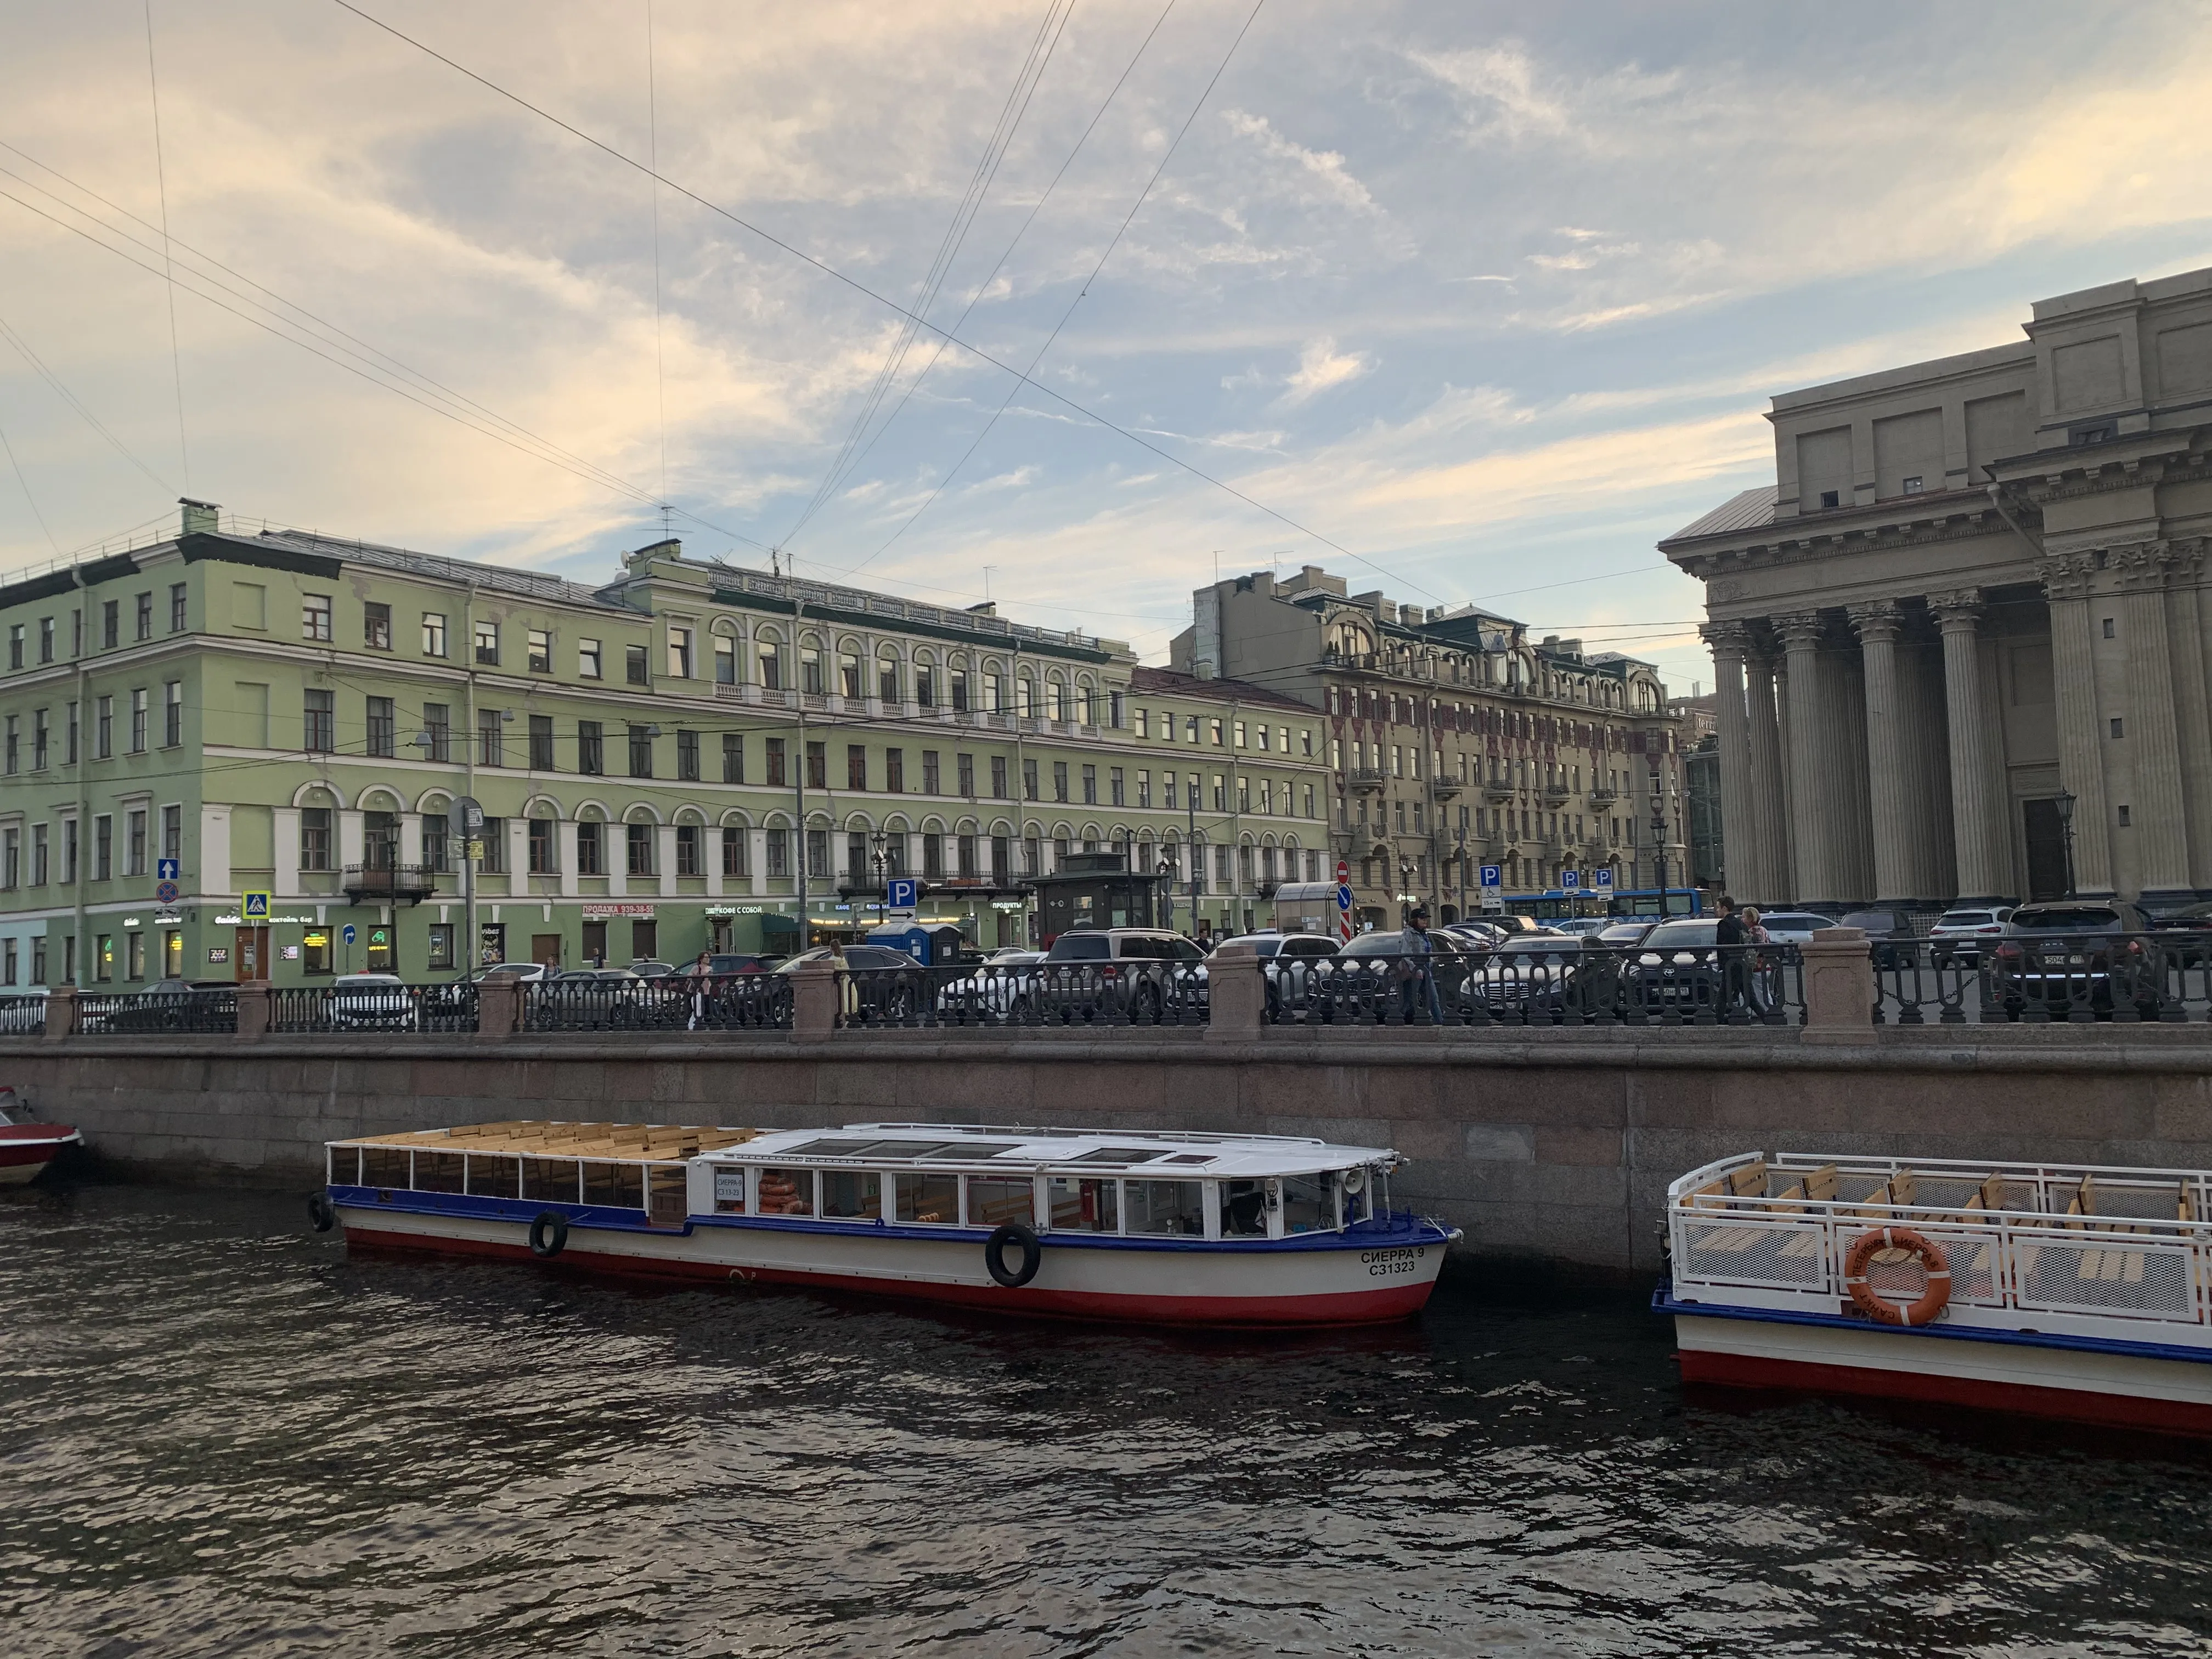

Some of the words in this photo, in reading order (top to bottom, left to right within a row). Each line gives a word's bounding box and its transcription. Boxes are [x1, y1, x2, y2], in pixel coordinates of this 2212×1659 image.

[1485, 868, 1496, 885] P
[1566, 872, 1575, 885] P
[1600, 871, 1609, 884] P
[896, 883, 911, 905] P
[1361, 1249, 1414, 1263] СИЕРРА
[1418, 1248, 1425, 1258] 9
[1892, 1235, 1932, 1262] СИЕРРА
